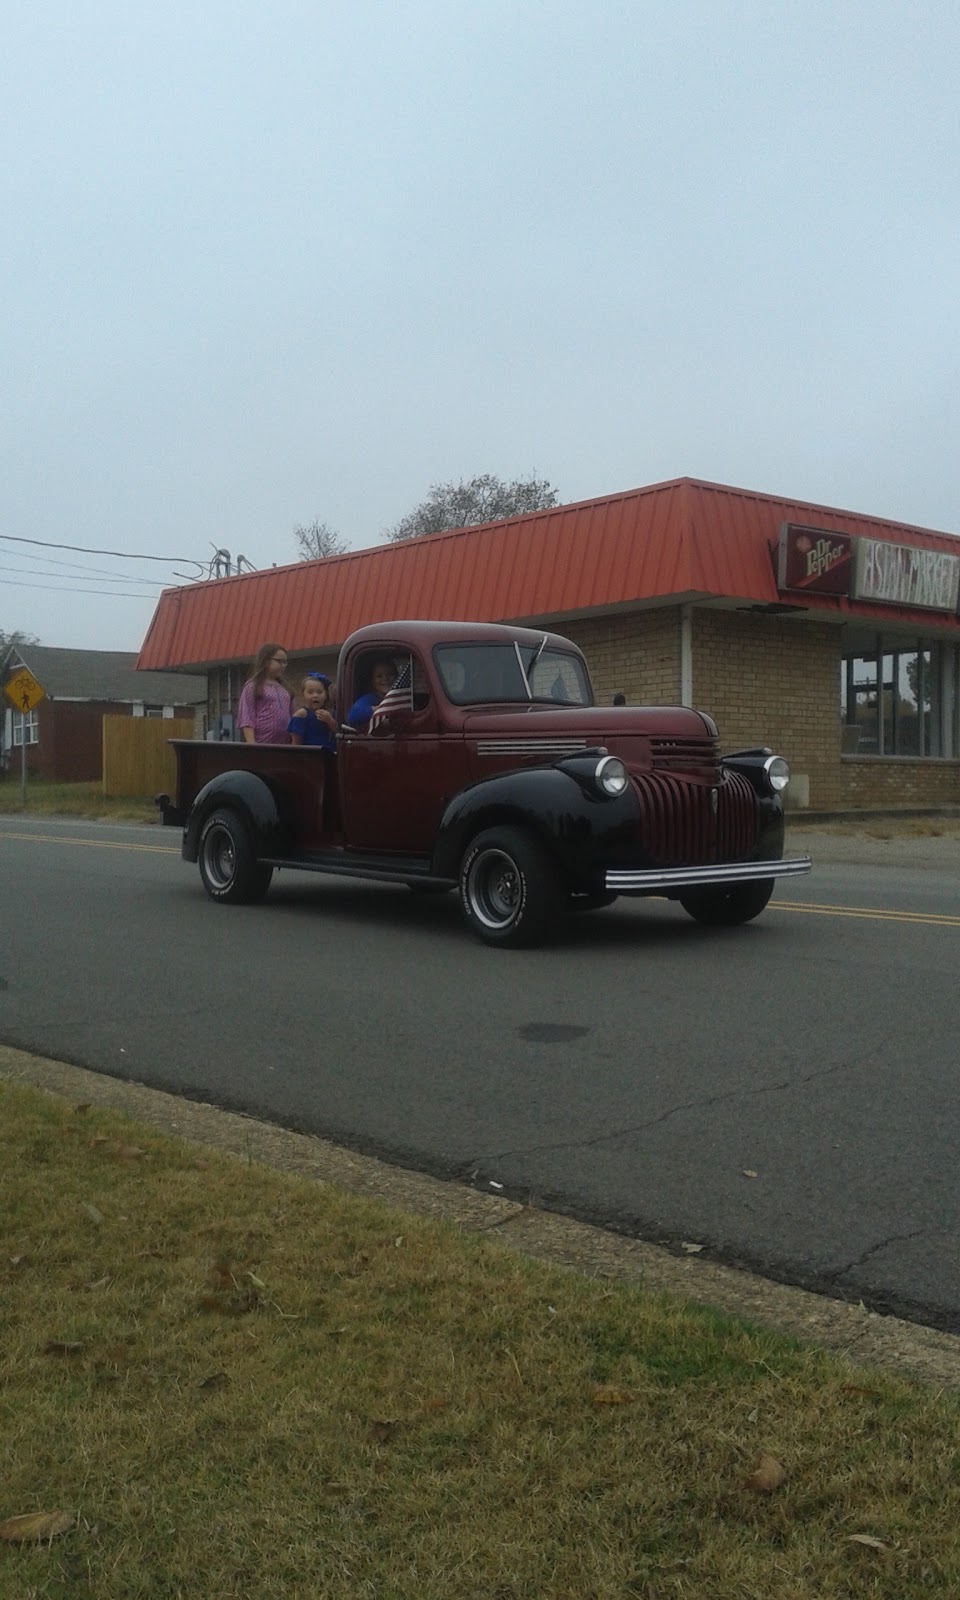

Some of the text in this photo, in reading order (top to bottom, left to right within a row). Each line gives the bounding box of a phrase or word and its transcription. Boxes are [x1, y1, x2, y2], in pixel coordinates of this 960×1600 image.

[806, 544, 844, 577] Pepper
[816, 538, 832, 559] Dr
[906, 547, 957, 608] MARKET
